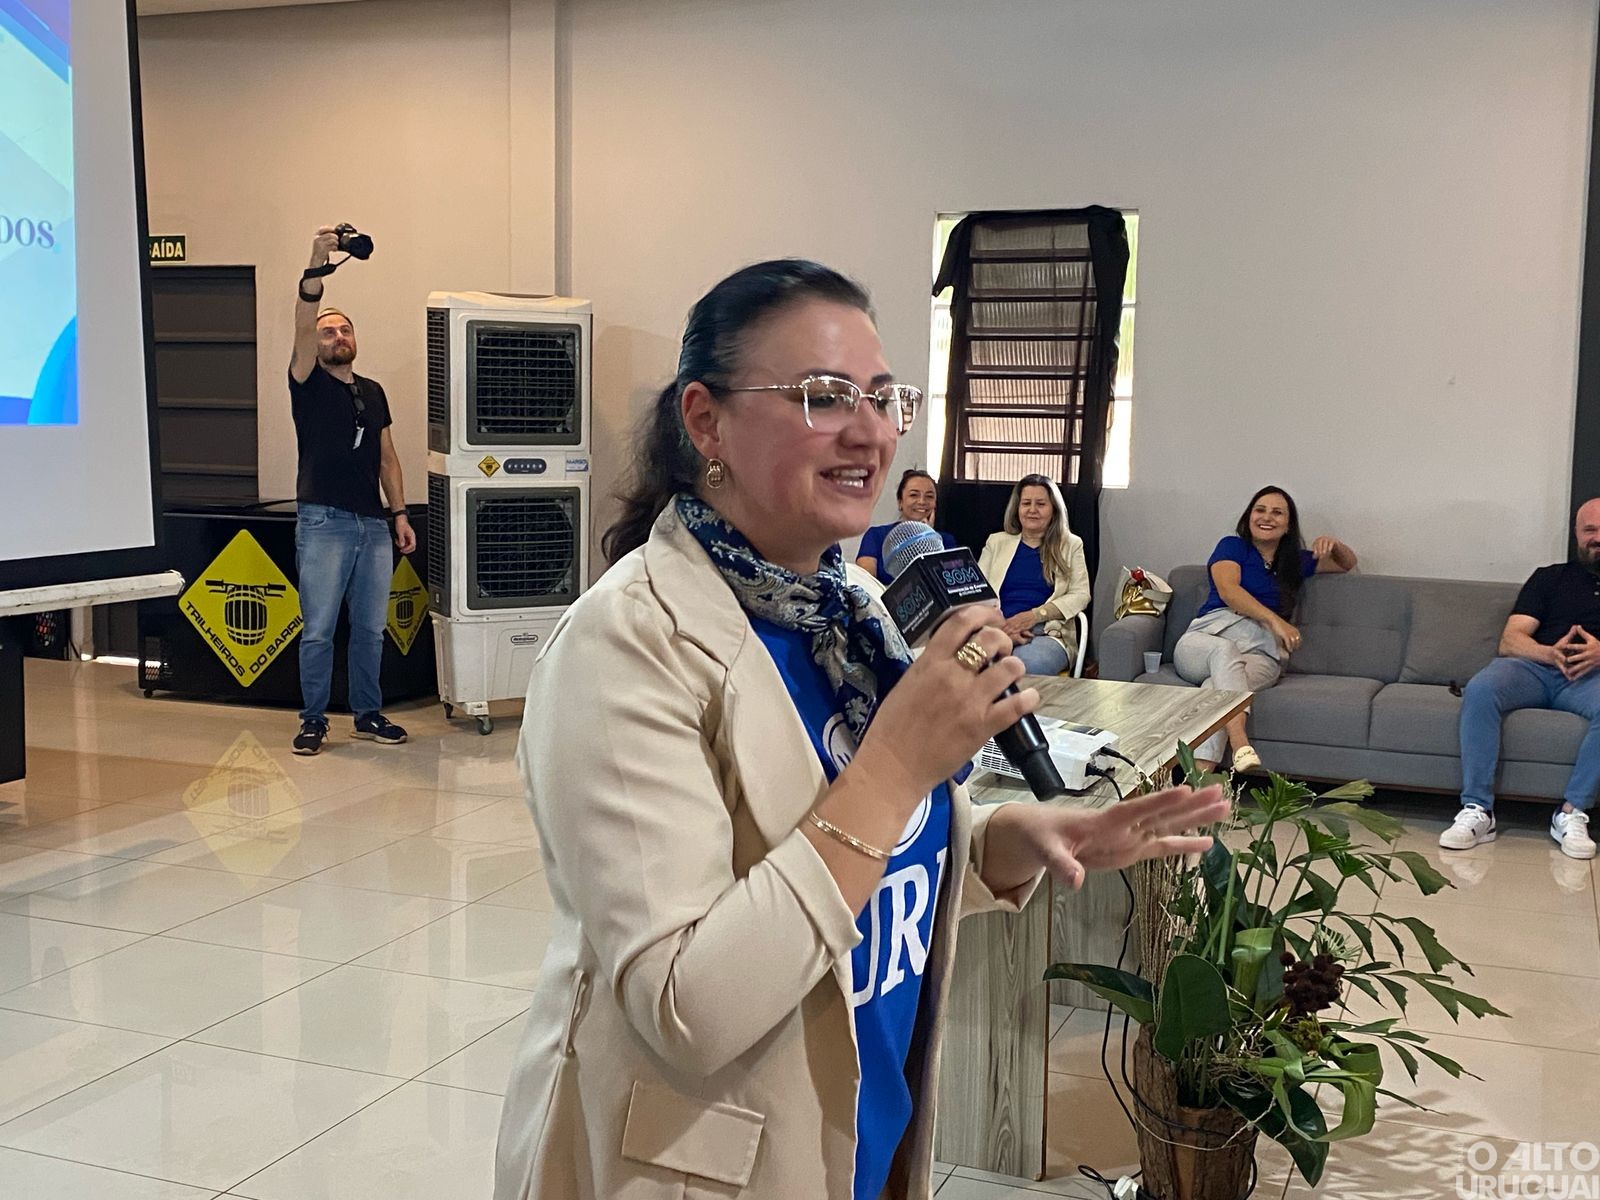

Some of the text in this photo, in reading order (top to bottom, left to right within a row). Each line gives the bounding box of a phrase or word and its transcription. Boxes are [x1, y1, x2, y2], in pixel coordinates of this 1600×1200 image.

[149, 239, 184, 258] AÍDA
[942, 566, 980, 586] SOM
[186, 601, 246, 677] TRILHEIROS
[249, 655, 268, 675] DO
